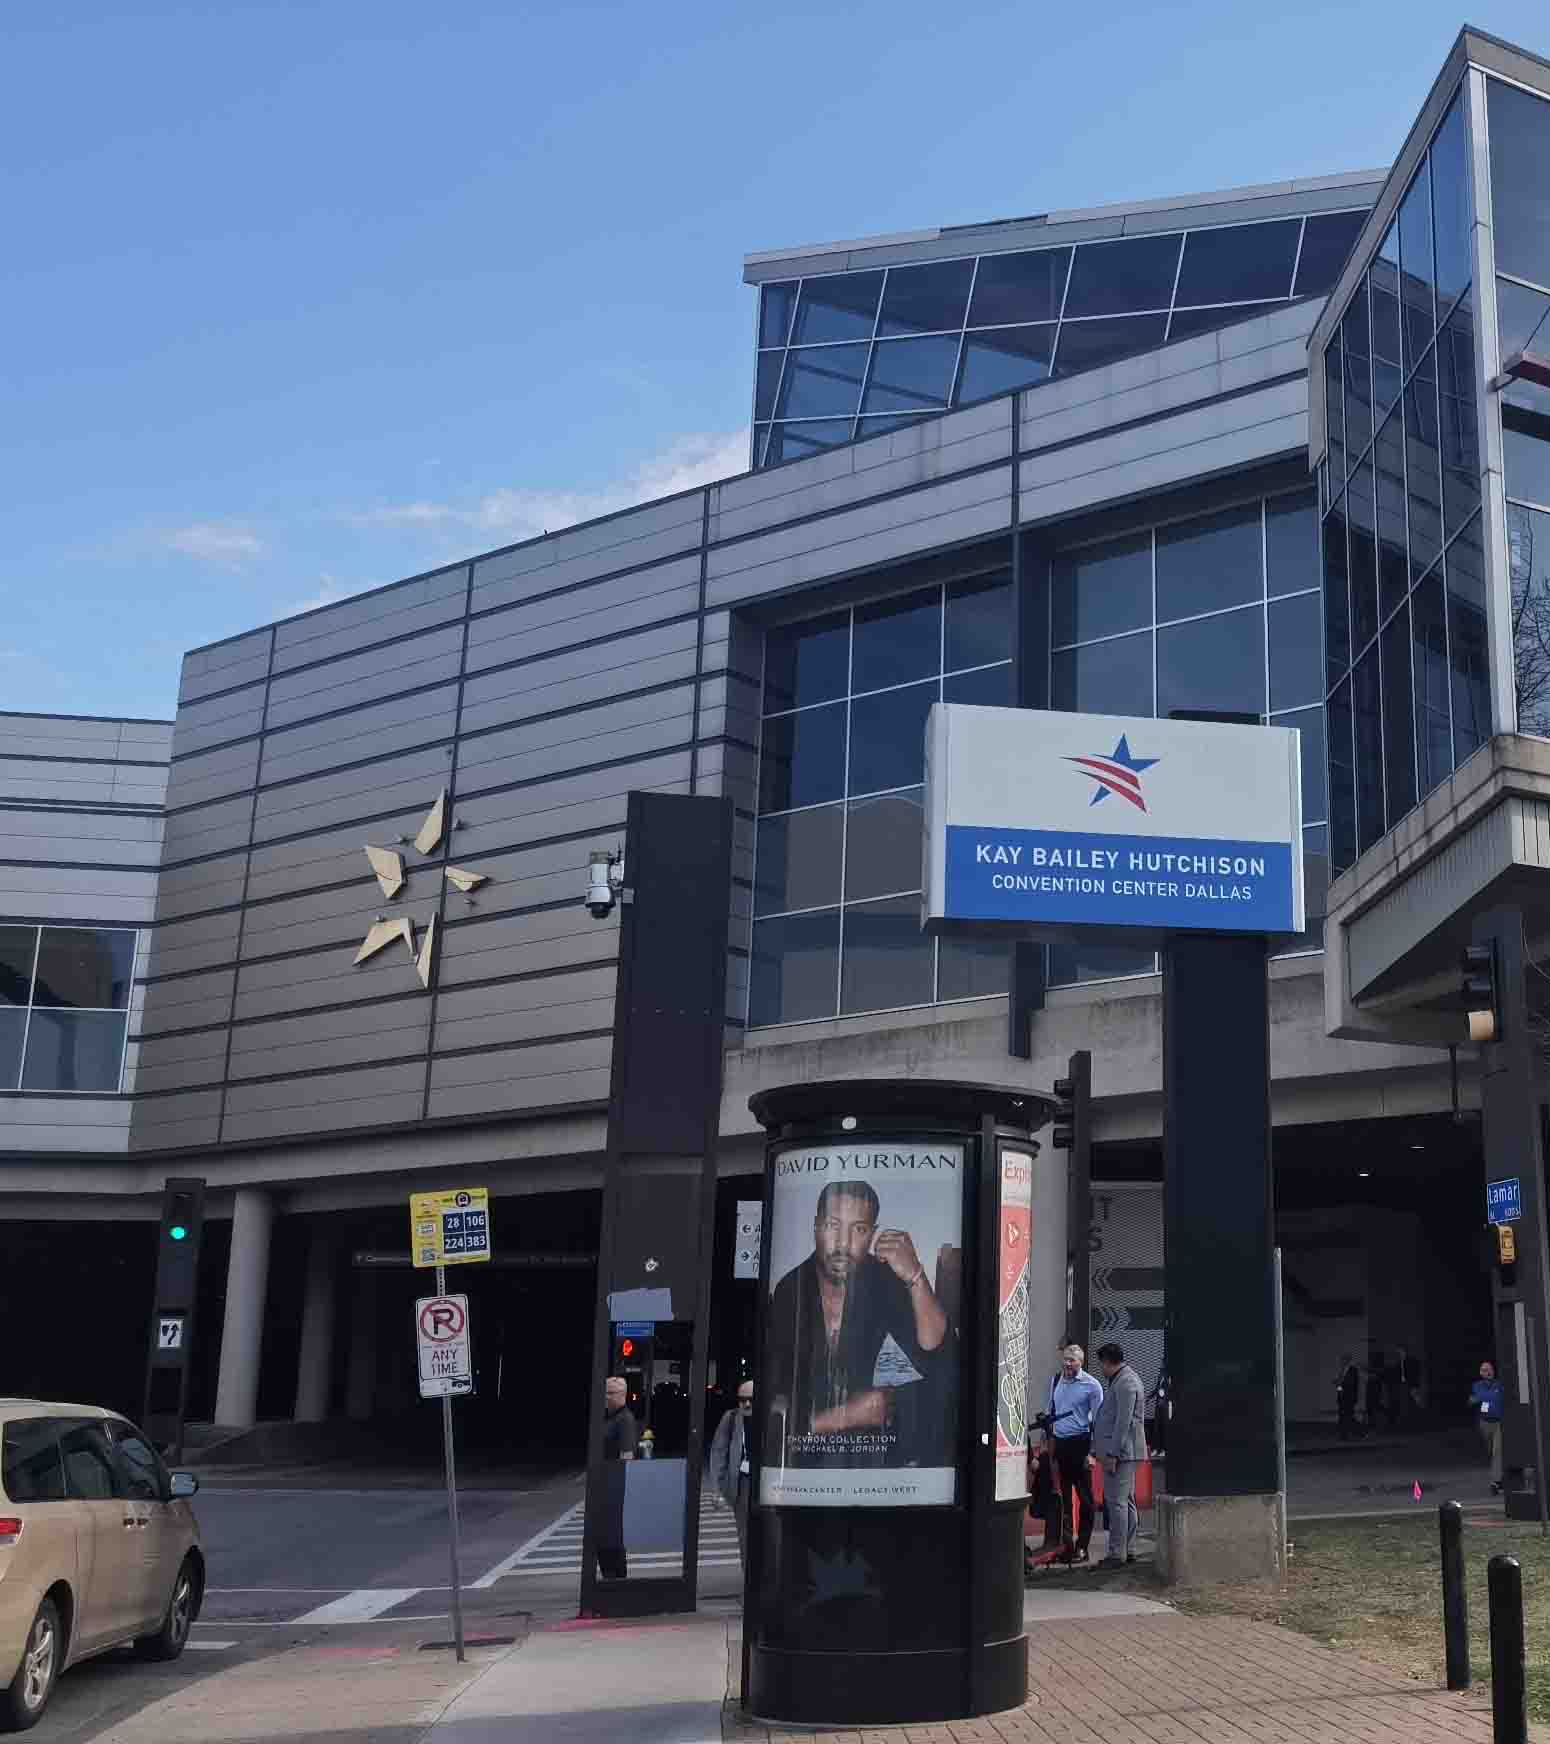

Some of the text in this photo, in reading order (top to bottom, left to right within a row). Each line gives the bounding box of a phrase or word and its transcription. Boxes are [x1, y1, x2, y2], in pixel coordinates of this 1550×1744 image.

[976, 844, 1265, 877] KAY BAILEY HUTCHISON
[992, 874, 1252, 900] CONVENTION CENTER DALLAS
[778, 1153, 956, 1177] DAVID YURMAN
[1489, 1185, 1517, 1204] Lamar
[447, 1217, 460, 1229] 28
[466, 1215, 485, 1227] 106
[445, 1235, 486, 1249] 224 383
[432, 1349, 457, 1361] ANY
[431, 1361, 458, 1377] TIME
[829, 1435, 897, 1444] COLLECTION
